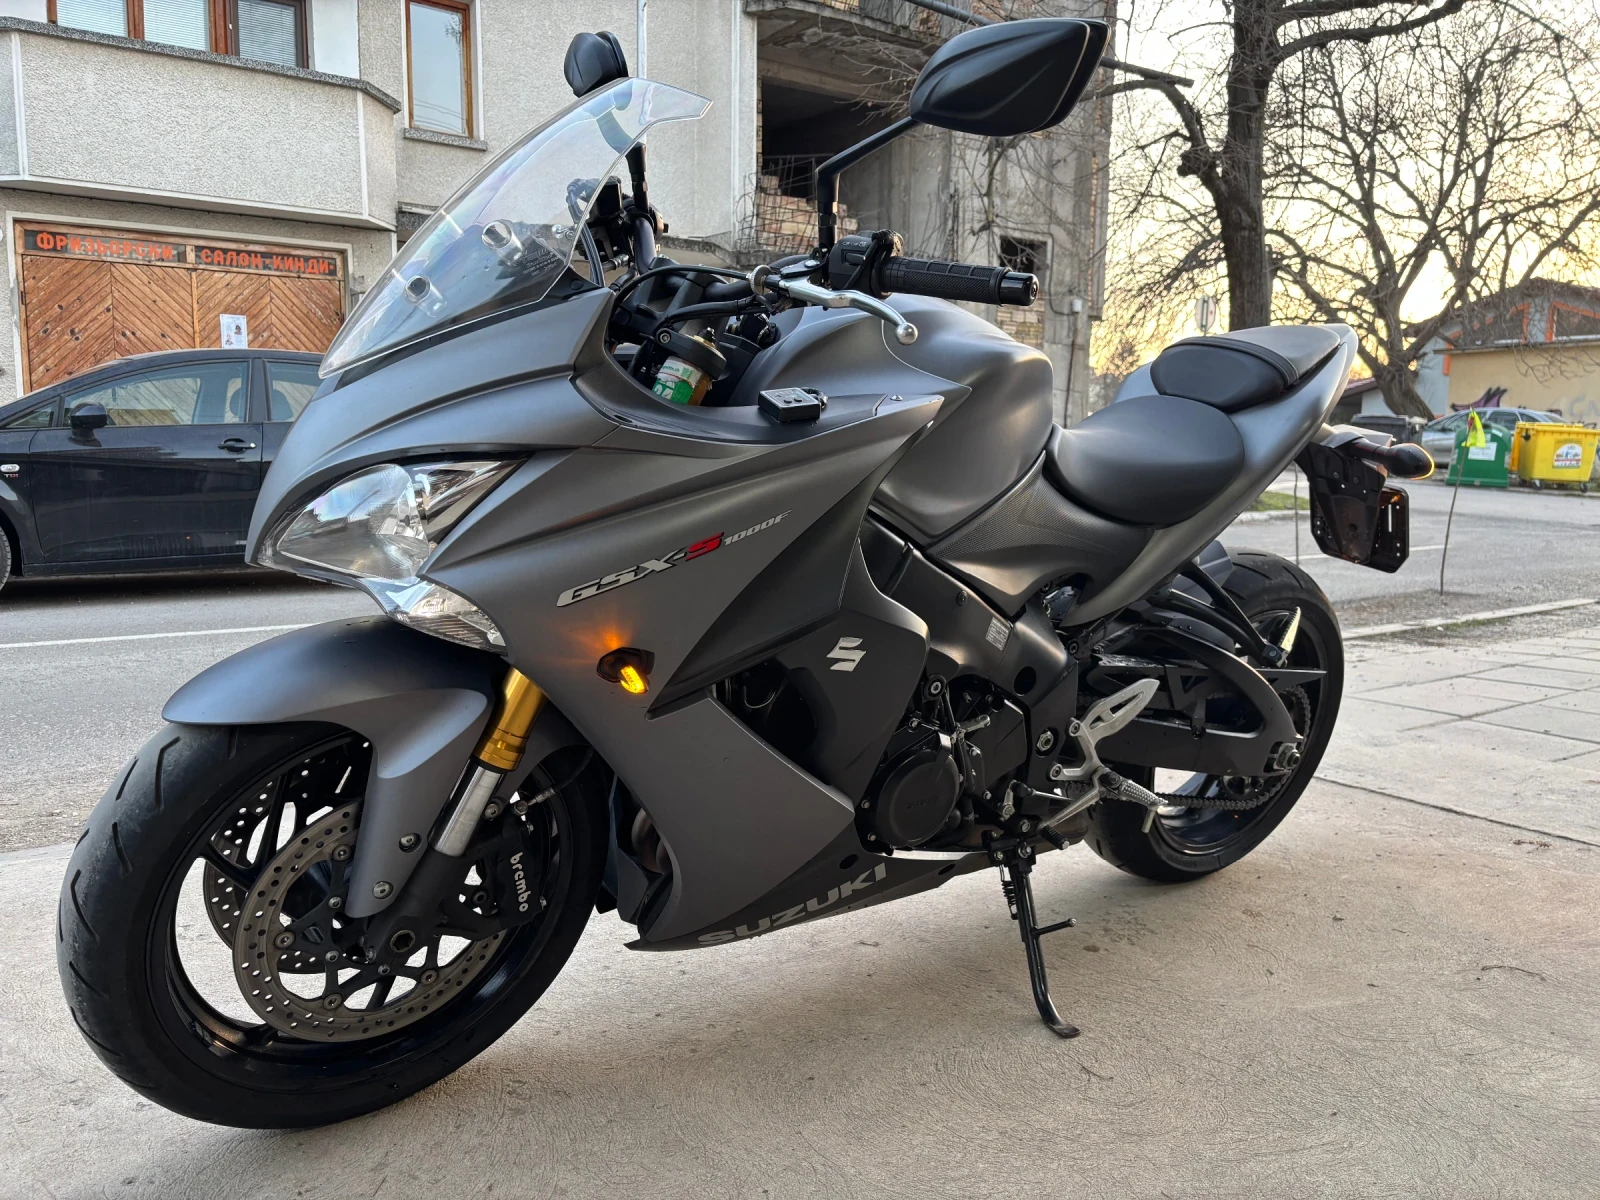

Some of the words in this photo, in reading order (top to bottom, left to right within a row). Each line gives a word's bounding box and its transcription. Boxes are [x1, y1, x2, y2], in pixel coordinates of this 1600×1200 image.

[36, 232, 174, 260] ФРИЗЬОРСКИ
[510, 851, 532, 912] brembo
[697, 862, 887, 945] SUZUKI
